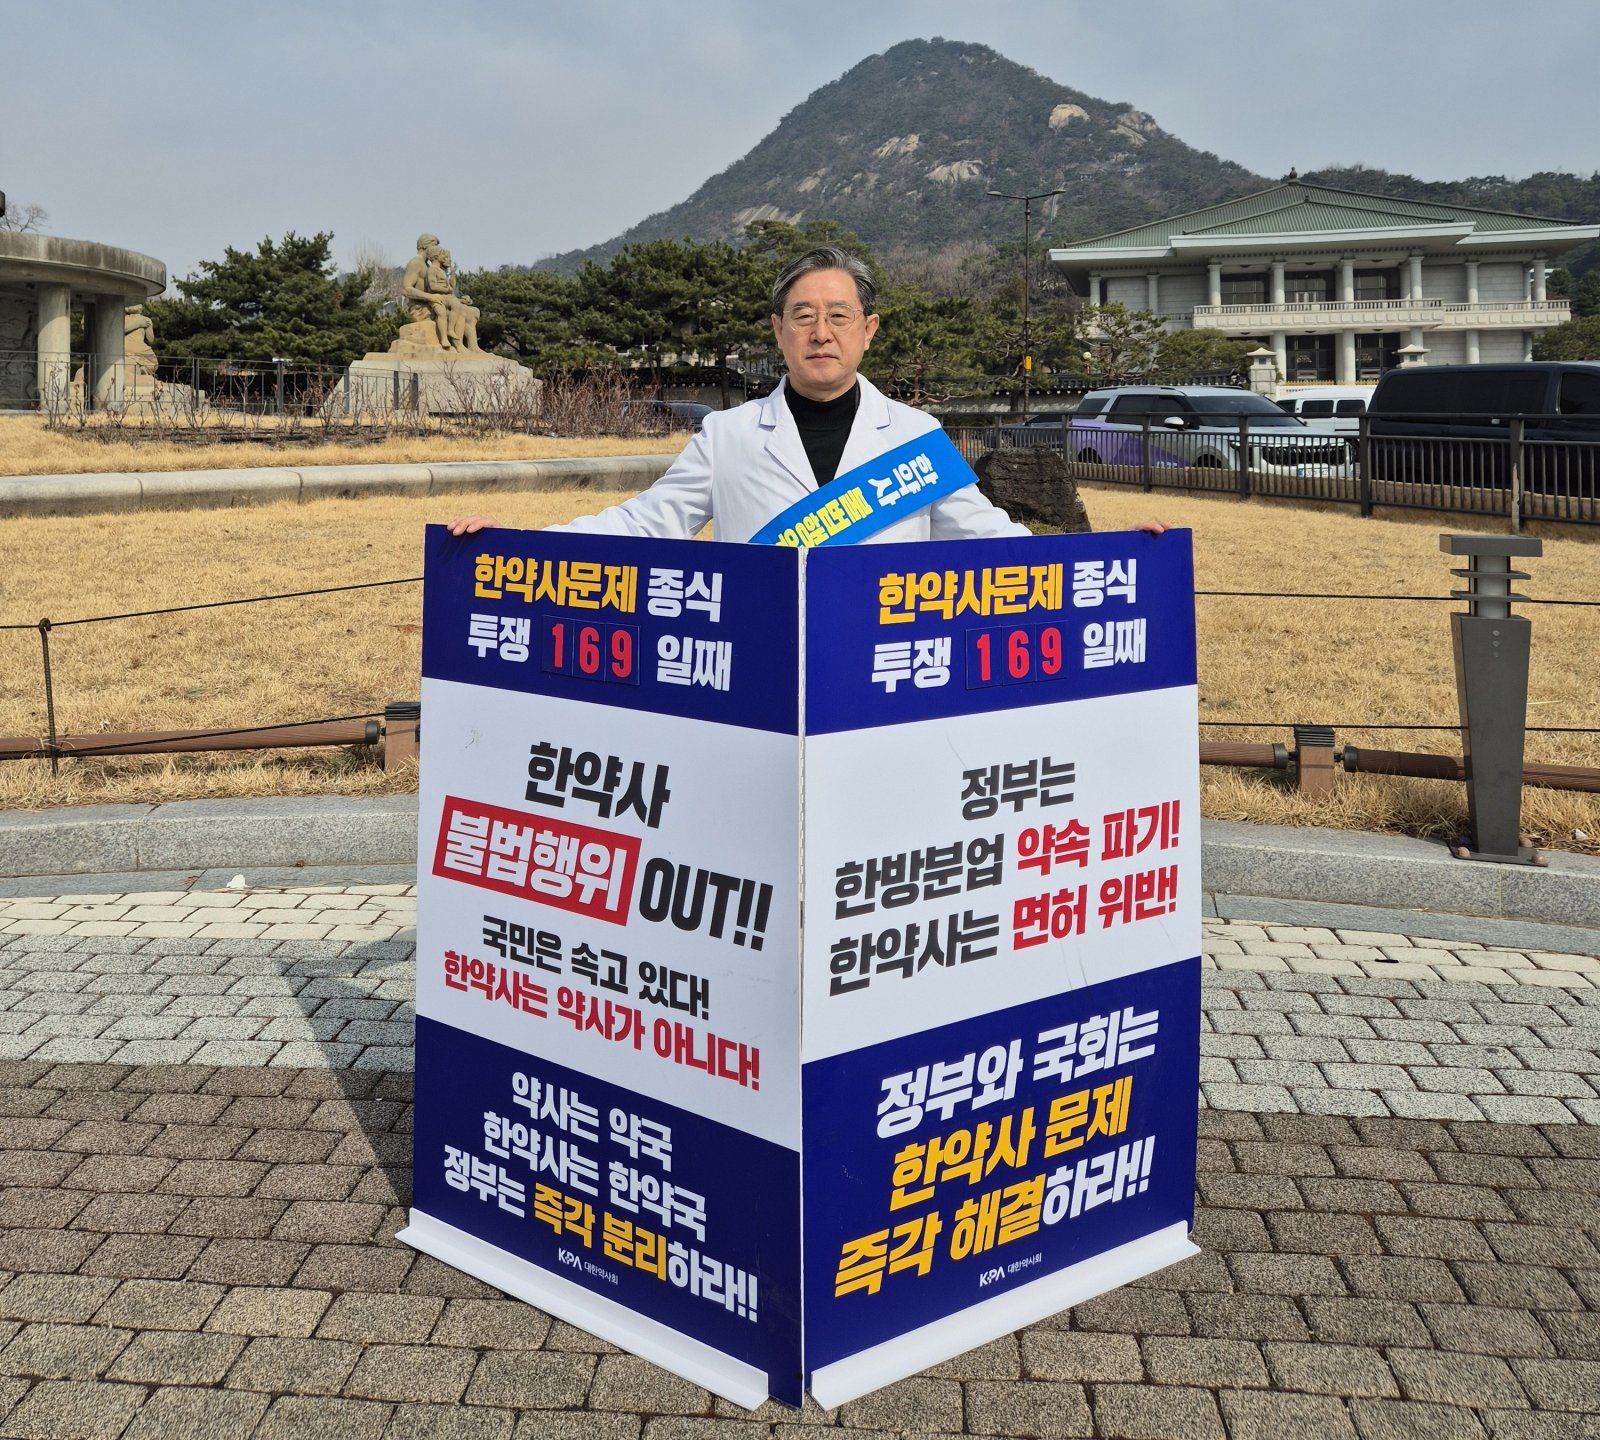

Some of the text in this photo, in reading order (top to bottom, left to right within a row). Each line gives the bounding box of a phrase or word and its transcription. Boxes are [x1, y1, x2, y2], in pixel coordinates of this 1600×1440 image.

[867, 453, 939, 507] 한약사
[474, 554, 723, 623] 한약사문제 종식
[878, 559, 1137, 625] 한약사문제 종식
[468, 613, 732, 691] 투쟁 169 일째
[871, 618, 1146, 693] 투쟁 169 일째
[525, 741, 671, 829] 한약사
[960, 756, 1076, 821] 정부는
[444, 810, 773, 952] 불법행위 OUT!!
[834, 800, 1181, 920] 한방분업 약속 파기!
[483, 914, 710, 1020] 국민은 속고 있다!
[829, 865, 1178, 997] 한약사는 면허 위반!
[444, 951, 760, 1091] 한약사는 약사가 아니다!
[876, 1006, 1159, 1138] 정부와 국회는
[512, 1072, 672, 1171] 약사는 약국
[890, 1075, 1133, 1211] 한약사 문제
[483, 1111, 707, 1243] 한약사는 한약국
[834, 1135, 1155, 1297] 즉각 해결하라!!
[443, 1145, 758, 1323] 정부는 즉각 분리하라!!
[558, 1247, 619, 1286] KPA 대한약사회
[979, 1252, 1042, 1287] KPA 대한약사회
